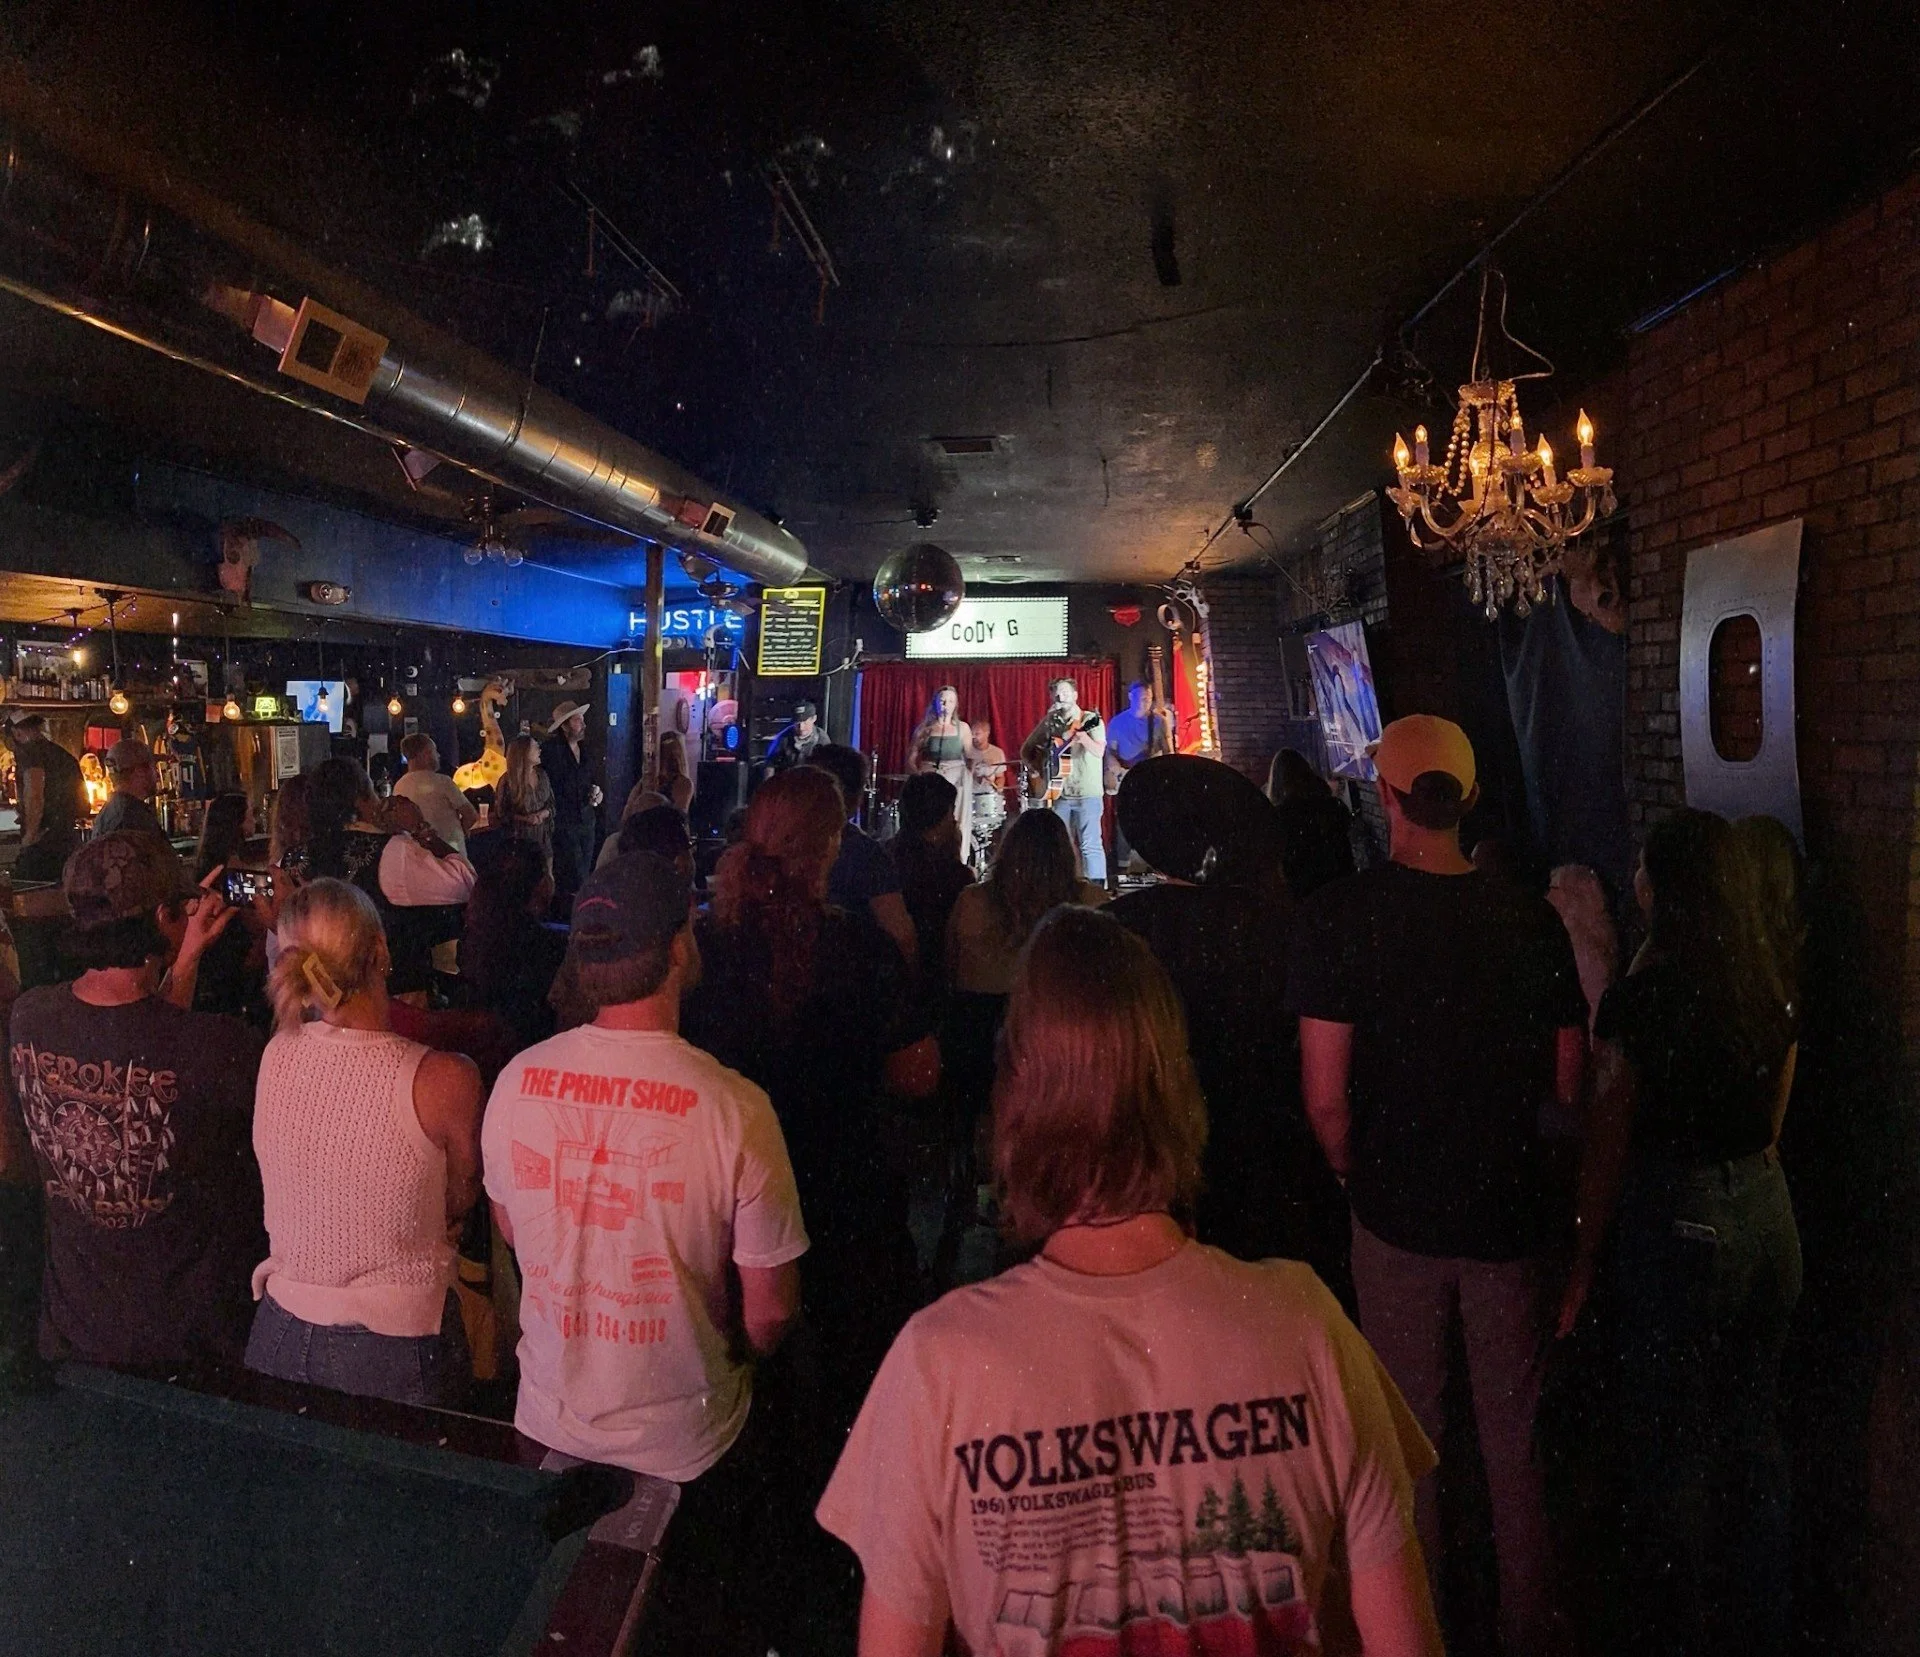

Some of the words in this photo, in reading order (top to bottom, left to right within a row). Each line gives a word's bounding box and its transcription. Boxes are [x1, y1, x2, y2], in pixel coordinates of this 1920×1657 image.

[951, 620, 995, 643] CODY
[1007, 619, 1019, 636] G
[520, 1067, 558, 1098] THE
[557, 1071, 632, 1108] PRINT
[630, 1078, 698, 1117] SHOP
[955, 1394, 1311, 1494] VOLKSWAGEN
[1122, 1472, 1157, 1492] BUS
